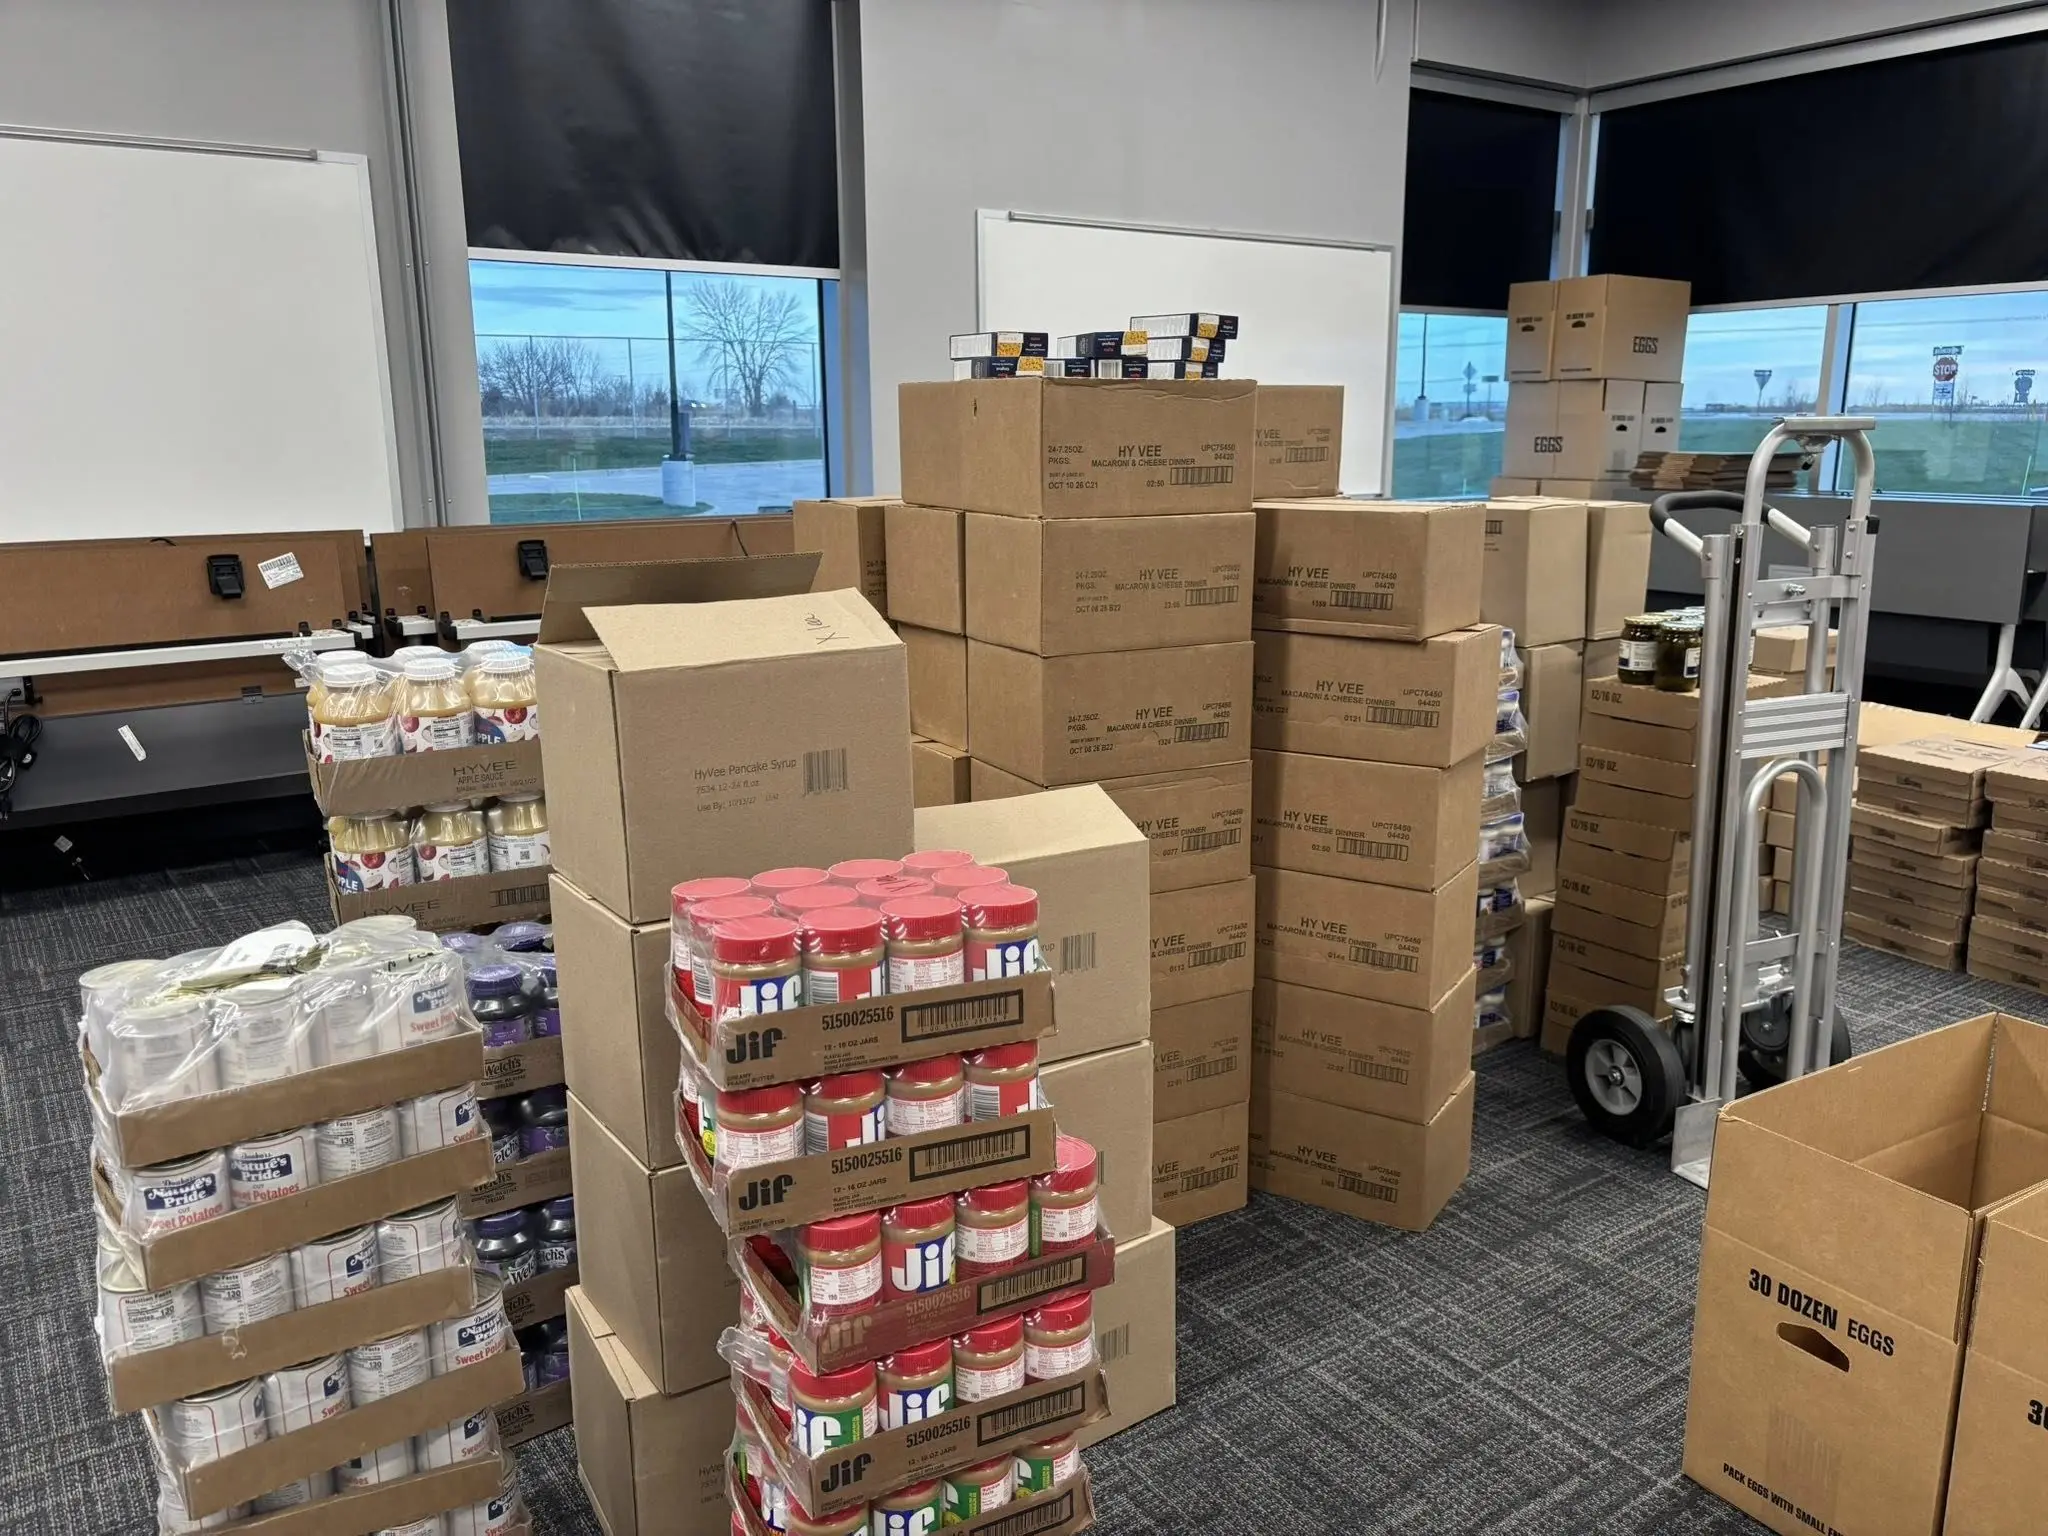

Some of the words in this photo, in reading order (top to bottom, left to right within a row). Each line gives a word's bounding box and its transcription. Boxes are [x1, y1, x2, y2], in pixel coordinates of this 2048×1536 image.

[1633, 336, 1658, 354] EGGS
[1934, 364, 1957, 375] STOP
[1264, 430, 1280, 439] VEE
[1119, 445, 1135, 457] HY
[1139, 445, 1161, 456] VEE
[1534, 436, 1563, 453] EGGS
[1048, 482, 1063, 490] OCT
[1140, 570, 1154, 580] HY
[1158, 569, 1178, 579] VEE
[1288, 566, 1302, 578] HY
[1306, 567, 1329, 578] VEE
[1115, 582, 1150, 590] MACARONI
[1158, 581, 1182, 589] CHEESE
[1185, 580, 1207, 588] DINNER
[1257, 577, 1292, 587] MACARONI
[1330, 582, 1355, 590] DINNER
[1316, 680, 1334, 692] HY
[1338, 682, 1364, 695] VEE
[1281, 689, 1322, 700] MACARONI
[1324, 693, 1329, 701] &
[1331, 694, 1363, 705] CHEESE
[1366, 696, 1395, 706] DINNER
[1136, 708, 1149, 720] HY
[1154, 706, 1172, 718] VEE
[1107, 722, 1141, 733] MACARONI
[1148, 719, 1172, 729] CHEESE
[1174, 718, 1197, 726] DINNER
[453, 760, 517, 776] HYVEE
[694, 768, 726, 780] HyVee
[728, 762, 768, 774] Pancake
[770, 758, 796, 771] Syrup
[458, 775, 480, 785] APPLE
[480, 772, 504, 782] SAUCE
[697, 804, 711, 812] Use
[712, 800, 726, 811] By:
[1156, 818, 1179, 829] VEE
[1284, 810, 1300, 823] HY
[1304, 812, 1328, 826] VEE
[1151, 829, 1179, 840] CHEESE
[1181, 826, 1206, 836] DINNER
[1257, 817, 1295, 830] MACARONI
[1296, 823, 1302, 831] &
[1304, 823, 1333, 835] CHEESE
[1336, 828, 1365, 839] DINNER
[1301, 917, 1318, 928] HY
[1321, 920, 1347, 935] VEE
[1151, 937, 1159, 948] Y
[1163, 934, 1185, 946] VEE
[1267, 922, 1306, 936] MACARONI
[1315, 931, 1346, 944] CHEESE
[1348, 938, 1377, 949] DINNER
[1158, 946, 1185, 957] CHEESE
[1187, 942, 1212, 951] DINNER
[410, 1020, 439, 1032] Sweet
[822, 1006, 894, 1031] 5150025516
[860, 1036, 878, 1045] JARS
[1302, 1029, 1317, 1040] HY
[1320, 1032, 1342, 1046] VEE
[726, 1028, 784, 1065] Jif
[1160, 1050, 1180, 1063] VEE
[485, 1058, 521, 1076] Welch's
[831, 1147, 903, 1175] 5150025516
[1297, 1145, 1312, 1157] HY
[1316, 1150, 1337, 1163] VEE
[232, 1156, 287, 1172] Nature's
[1158, 1161, 1178, 1174] VEE
[242, 1168, 280, 1181] Pride
[868, 1177, 887, 1186] JARS
[164, 1190, 207, 1208] Pride
[253, 1183, 299, 1200] Potatoes
[738, 1174, 794, 1212] Jif
[892, 1230, 955, 1292] Jif
[227, 1290, 241, 1298] 130
[906, 1284, 971, 1318] 5150025516
[1748, 1268, 1772, 1297] 30
[1776, 1282, 1838, 1331] DOZEN
[1846, 1317, 1895, 1357] EGGS
[456, 1350, 484, 1364] Sweet
[878, 1383, 950, 1428] Jif
[906, 1416, 971, 1448] 5150025516
[940, 1446, 957, 1456] JARS
[821, 1453, 871, 1493] Jif
[1722, 1462, 1746, 1486] PACK
[1747, 1476, 1770, 1500] EGGS
[1770, 1490, 1794, 1516] WITH
[1795, 1506, 1826, 1536] SMALL
